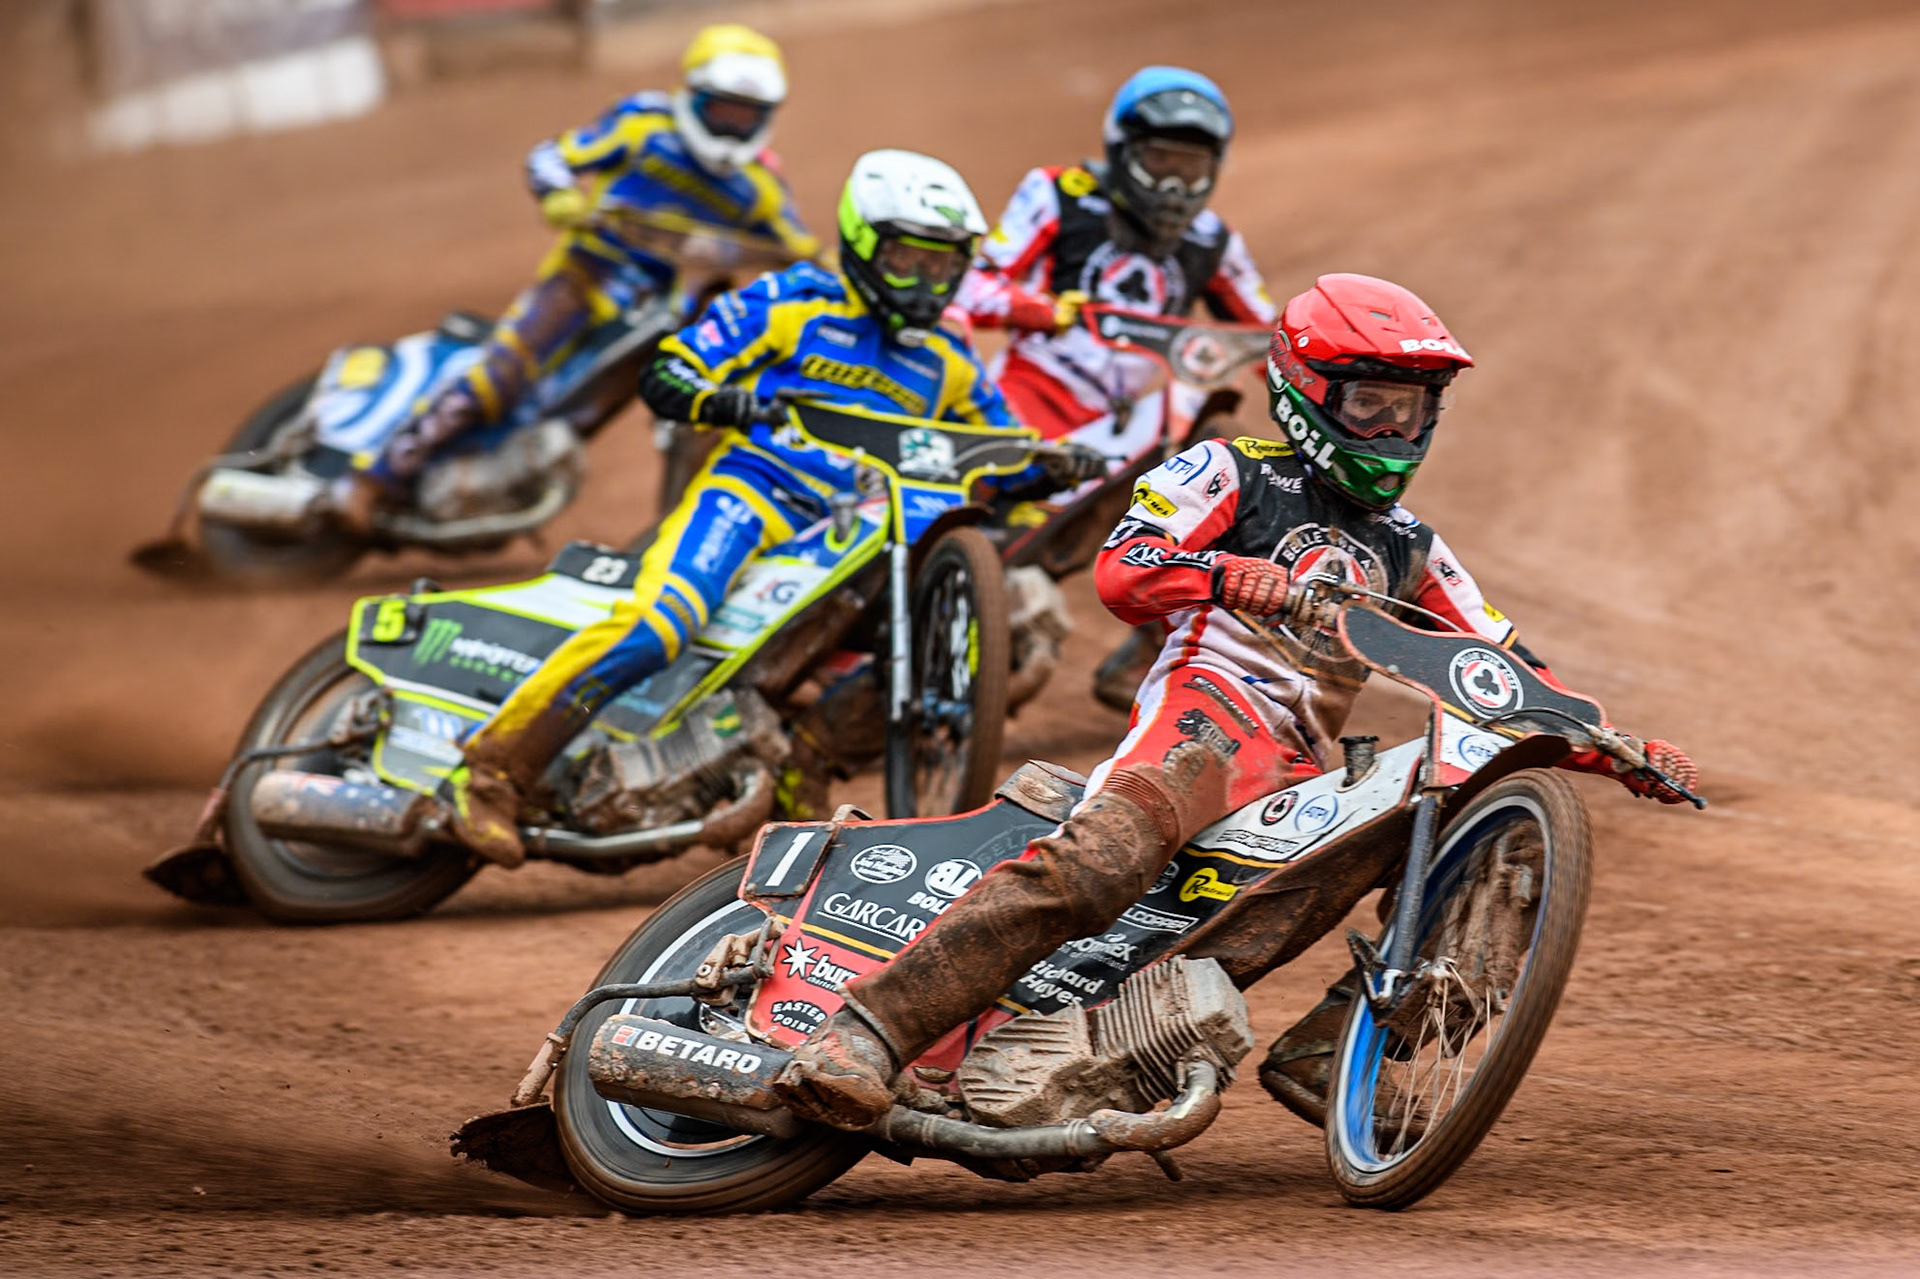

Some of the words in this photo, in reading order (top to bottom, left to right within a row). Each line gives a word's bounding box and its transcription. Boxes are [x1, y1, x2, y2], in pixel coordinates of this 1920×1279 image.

[1281, 530, 1325, 562] BELLE
[372, 600, 407, 642] 5
[765, 831, 816, 887] 1
[823, 892, 927, 941] GARCAR
[772, 1013, 817, 1034] POINT
[635, 1030, 763, 1074] BETARD
